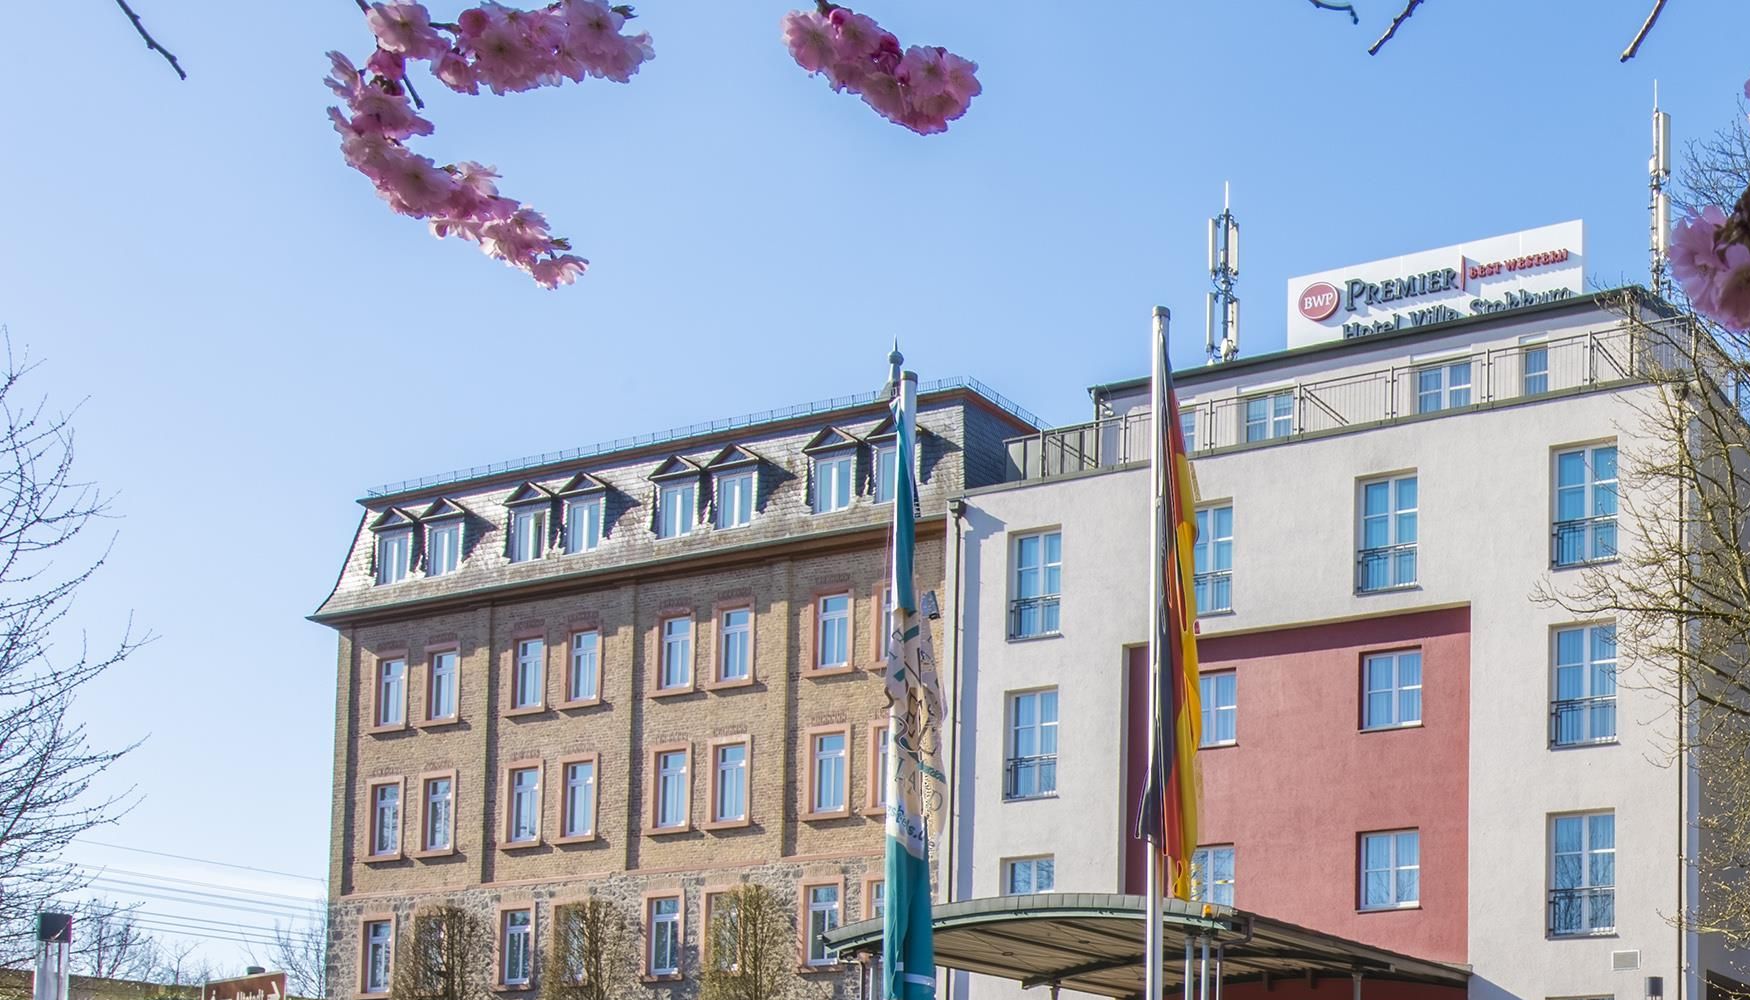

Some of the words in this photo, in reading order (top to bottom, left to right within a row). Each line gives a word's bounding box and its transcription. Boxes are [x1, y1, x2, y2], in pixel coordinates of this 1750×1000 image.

[1504, 248, 1569, 272] WESTERN
[1304, 292, 1333, 310] BWP
[1342, 312, 1400, 340] Hotel
[1408, 304, 1460, 328] Villa
